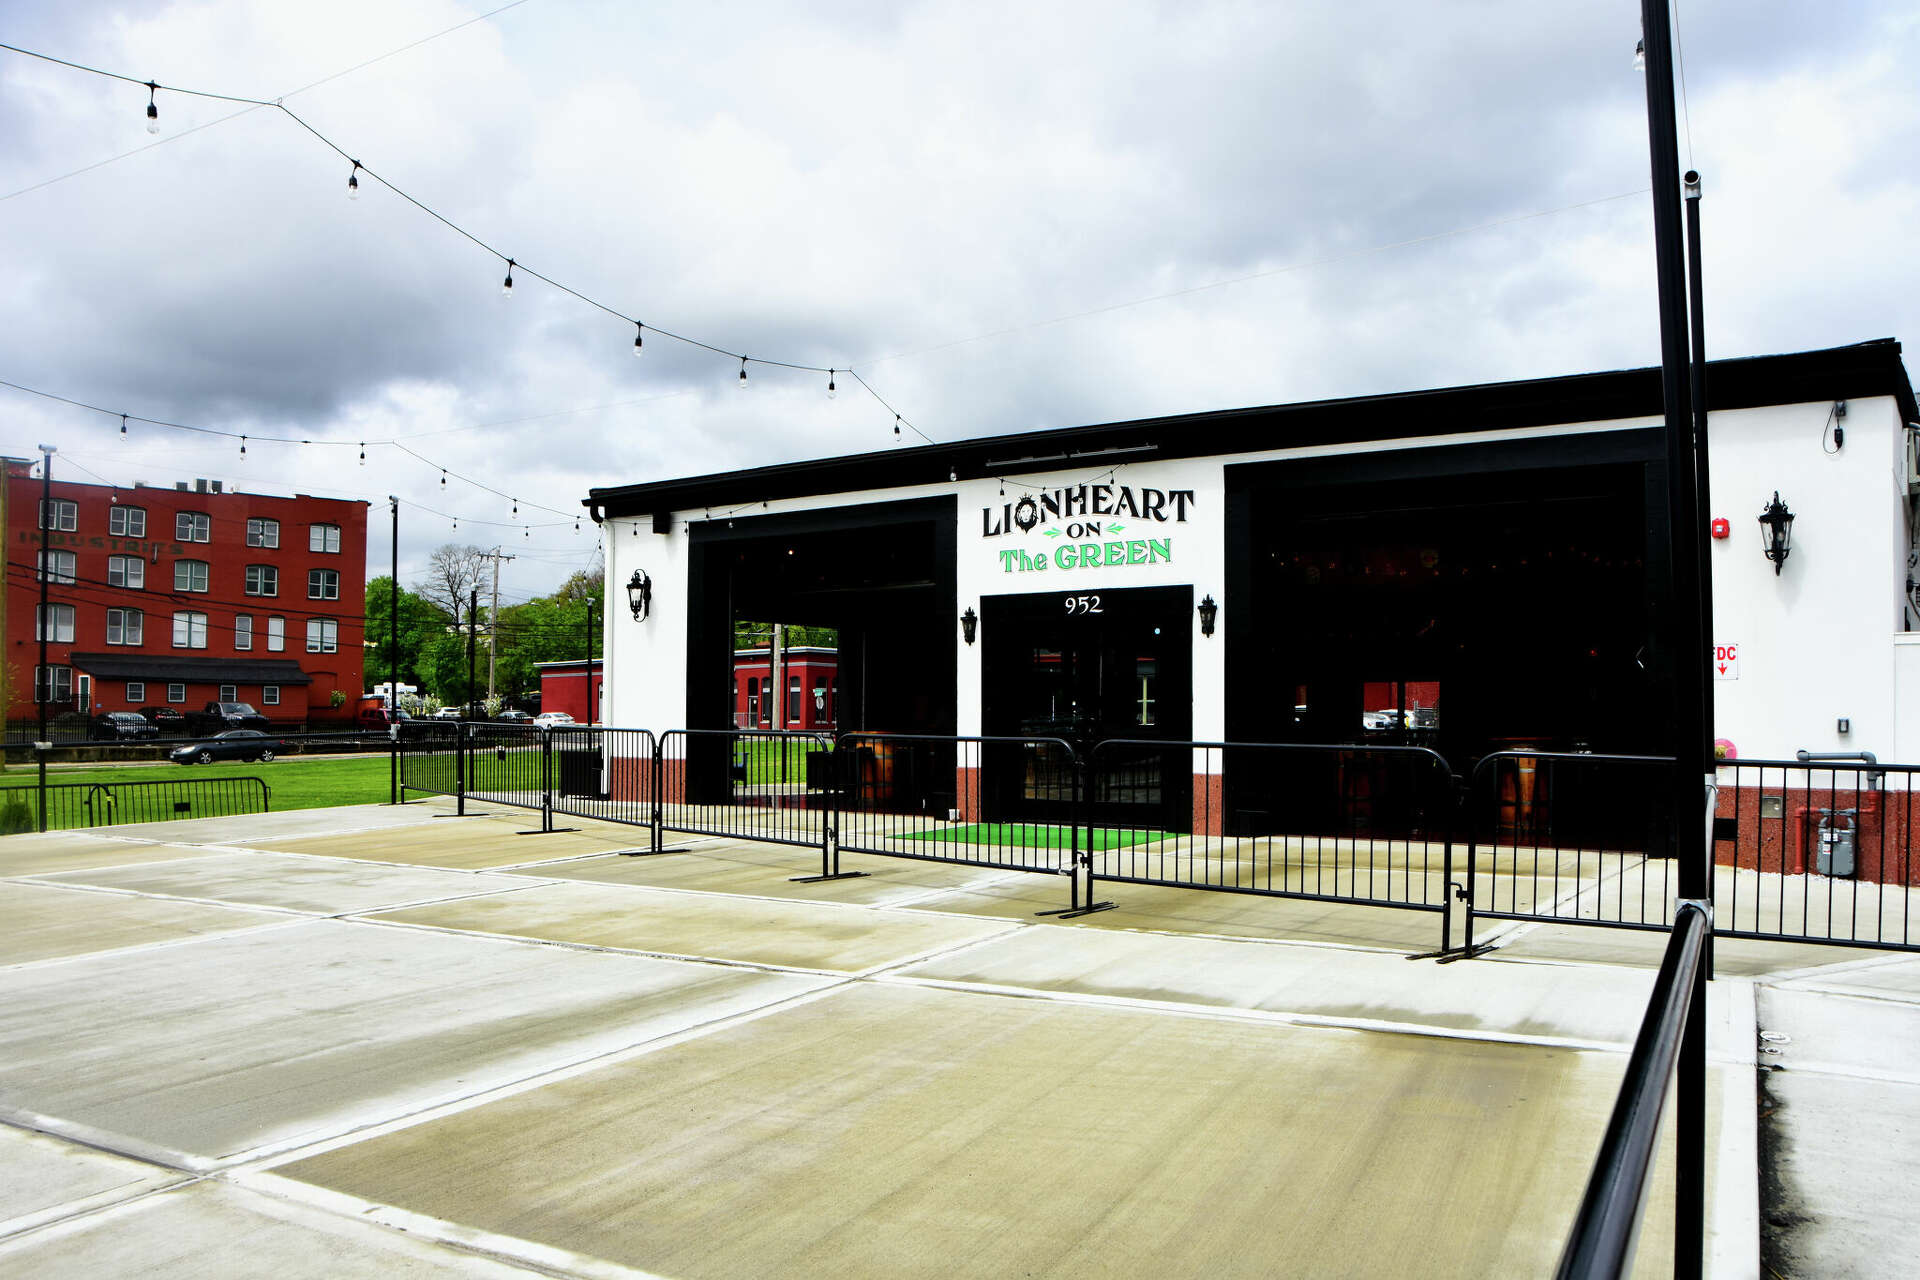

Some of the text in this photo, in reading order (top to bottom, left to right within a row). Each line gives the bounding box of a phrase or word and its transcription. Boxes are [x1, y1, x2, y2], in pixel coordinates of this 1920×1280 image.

[982, 484, 1195, 538] LIONHEART
[1066, 521, 1101, 539] ON
[1000, 538, 1172, 573] The GREEN
[1065, 595, 1104, 615] 952
[1713, 646, 1737, 661] DC
